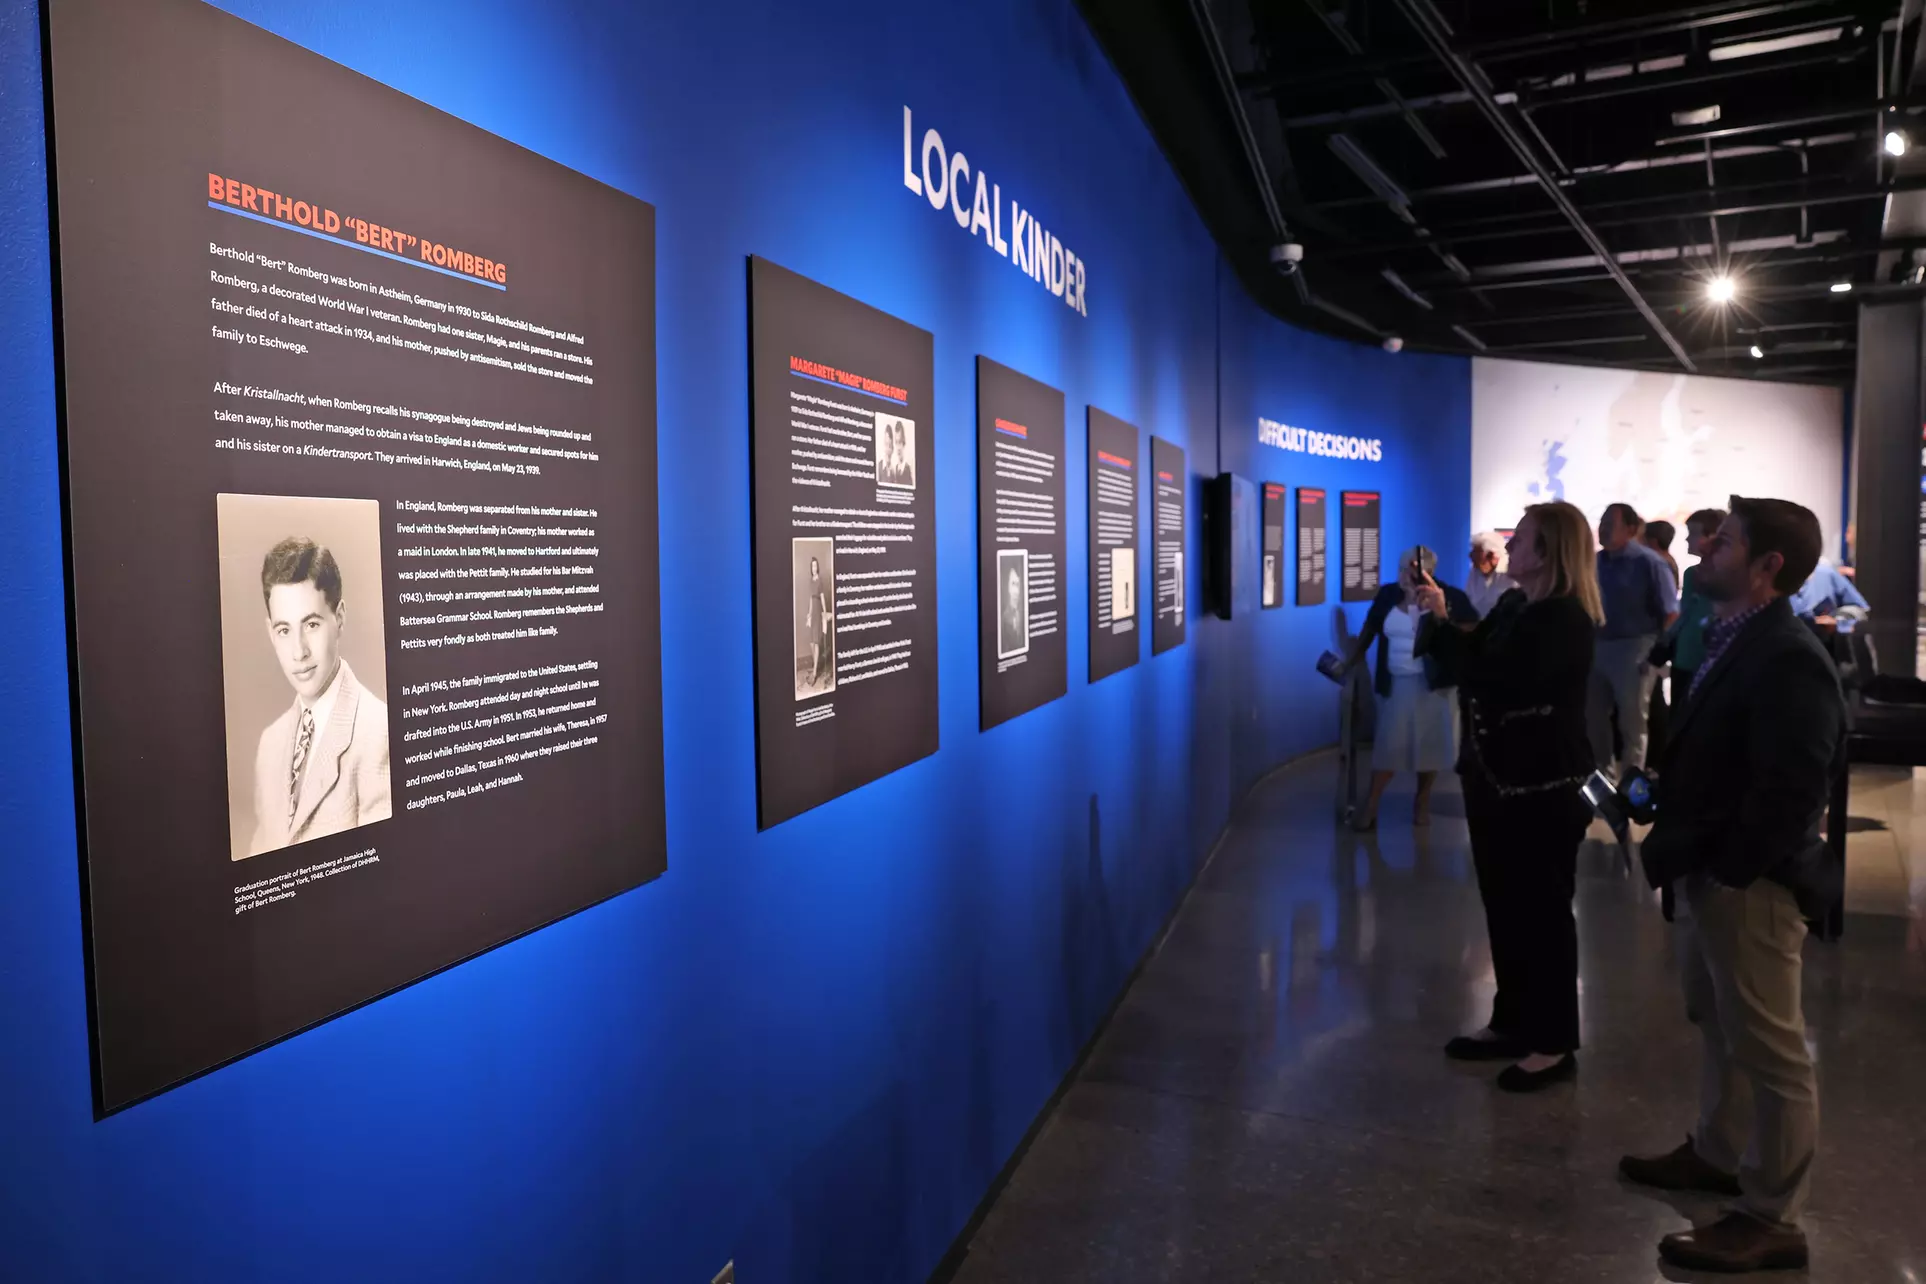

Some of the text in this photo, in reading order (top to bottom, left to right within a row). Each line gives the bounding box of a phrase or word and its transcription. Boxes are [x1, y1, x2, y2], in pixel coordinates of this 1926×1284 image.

[904, 105, 1087, 317] LOCAL KINDER
[208, 173, 506, 283] BERTHOLD “BERT” ROMBERG
[210, 242, 481, 319] Berthold “Bert” Romberg was born in Astheim, Germany in 1930 to
[211, 270, 260, 294] Romberg,
[261, 285, 268, 293] a
[269, 284, 316, 304] decorated
[318, 295, 345, 311] World
[346, 301, 365, 315] War
[366, 306, 369, 316] I
[370, 309, 402, 324] veteran.
[403, 315, 436, 333] Romberg
[437, 322, 451, 334] had
[451, 328, 465, 338] one
[211, 298, 244, 315] father
[245, 305, 267, 320] died
[268, 311, 280, 322] of
[281, 315, 287, 324] a
[288, 313, 314, 329] heart
[315, 321, 343, 335] attack
[344, 325, 353, 337] in
[354, 328, 375, 343] 1934,
[376, 334, 391, 344] and
[392, 335, 403, 347] his
[434, 346, 459, 358] pushed
[460, 349, 469, 362] by
[212, 325, 309, 354] family to Eschwege.
[790, 356, 835, 380] MARGARETE
[213, 382, 471, 428] After Kristallnacht, when Romberg recalls his synagogue being
[214, 410, 244, 423] taken
[245, 415, 274, 428] away,
[275, 416, 289, 428] his
[290, 419, 324, 431] mother
[325, 424, 364, 437] managed
[365, 427, 375, 437] to
[376, 428, 402, 440] obtain
[408, 431, 424, 442] visa
[424, 434, 433, 443] to
[434, 434, 462, 447] England
[463, 439, 471, 448] as
[1258, 417, 1382, 461] DIFFICULT DECISIONS
[215, 438, 234, 449] and
[236, 438, 252, 450] his
[253, 440, 281, 453] sister
[282, 445, 294, 454] on
[296, 446, 302, 455] a
[303, 445, 374, 462] Kindertransport.
[374, 451, 395, 465] They
[395, 454, 423, 465] arrived
[423, 455, 431, 466] in
[396, 500, 404, 510] In
[437, 502, 469, 515] Romberg
[397, 523, 479, 536] lived with the Shepherd
[403, 546, 422, 556] maid
[423, 546, 431, 556] in
[460, 547, 467, 556] In
[467, 546, 481, 556] late
[415, 569, 439, 581] placed
[439, 568, 456, 578] with
[456, 568, 468, 578] the
[399, 592, 425, 604] (1943),
[425, 591, 454, 603] through
[400, 614, 469, 626] Battersea Grammar
[401, 638, 426, 649] Pettits
[427, 638, 443, 648] very
[444, 634, 466, 646] fondly
[402, 686, 410, 696] In
[411, 682, 430, 696] April
[449, 679, 462, 689] the
[462, 676, 483, 687] family
[403, 709, 411, 719] in
[412, 707, 429, 717] New
[449, 699, 479, 711] Romberg
[404, 727, 432, 742] drafted
[432, 726, 447, 736] into
[448, 723, 460, 733] the
[405, 741, 482, 764] worked while finishing
[406, 775, 420, 788] and
[421, 769, 445, 784] moved
[446, 769, 454, 778] to
